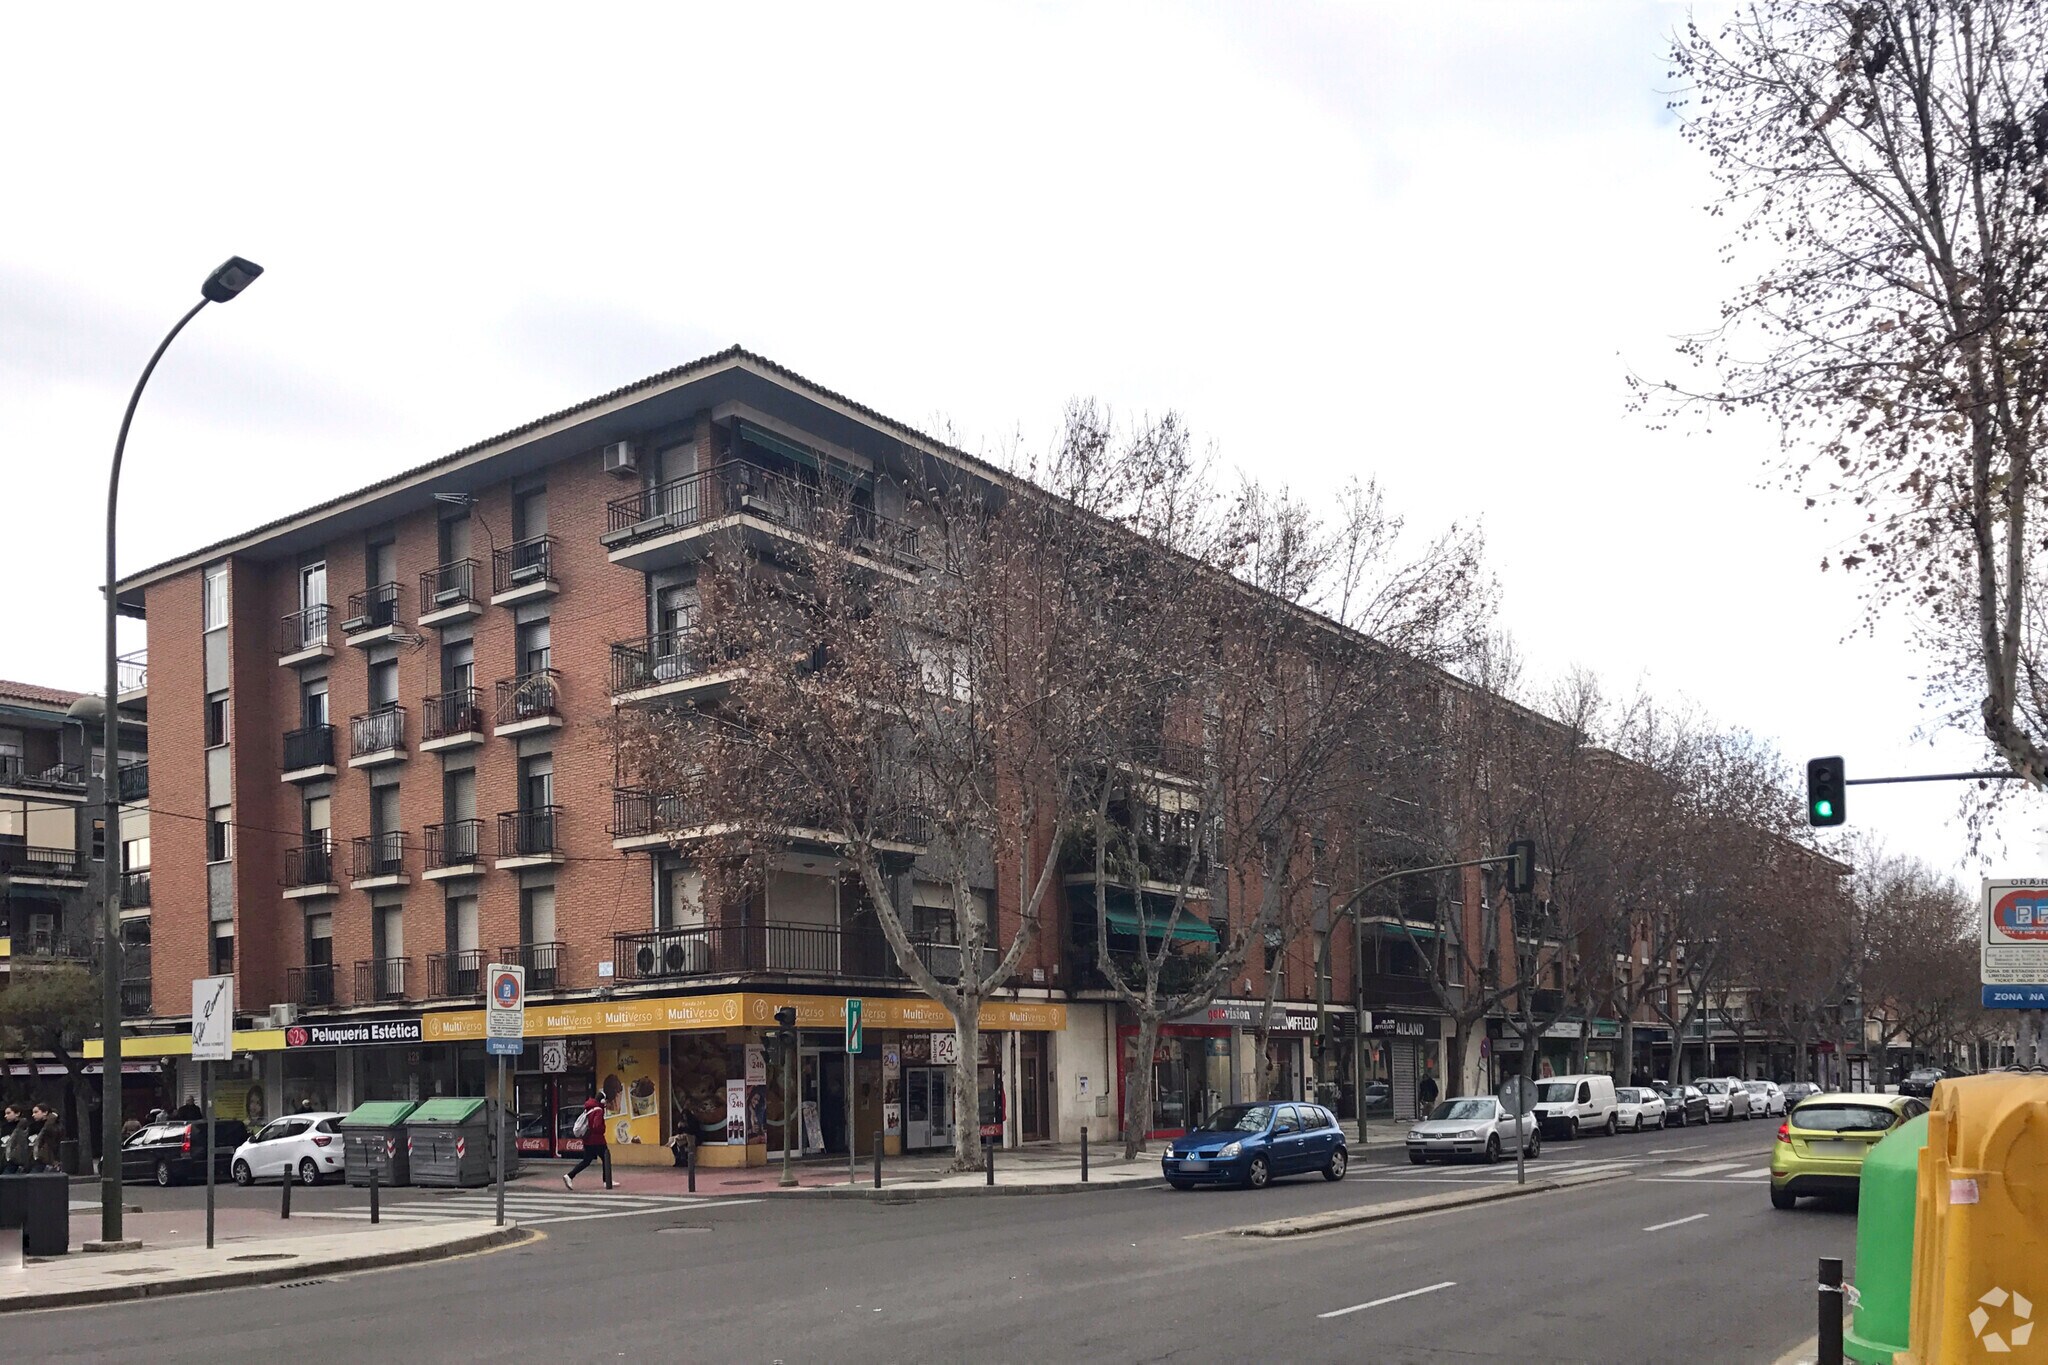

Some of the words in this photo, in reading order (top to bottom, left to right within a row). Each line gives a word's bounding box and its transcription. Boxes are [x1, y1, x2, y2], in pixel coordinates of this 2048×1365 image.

[1994, 993, 2023, 1001] ZONA
[605, 1011, 653, 1024] MultiVerso
[668, 1007, 720, 1020] MultiVerso
[903, 1008, 944, 1021] MultiVerso
[1009, 1011, 1046, 1023] MultiVerso
[443, 1020, 482, 1032] MultiVerso
[547, 1015, 592, 1027] MultiVerso
[311, 1025, 369, 1045] Peluquería
[371, 1022, 419, 1040] Estética
[939, 1040, 954, 1057] 24
[543, 1053, 556, 1067] 24
[751, 1061, 765, 1069] 24h
[731, 1100, 744, 1108] 24h
